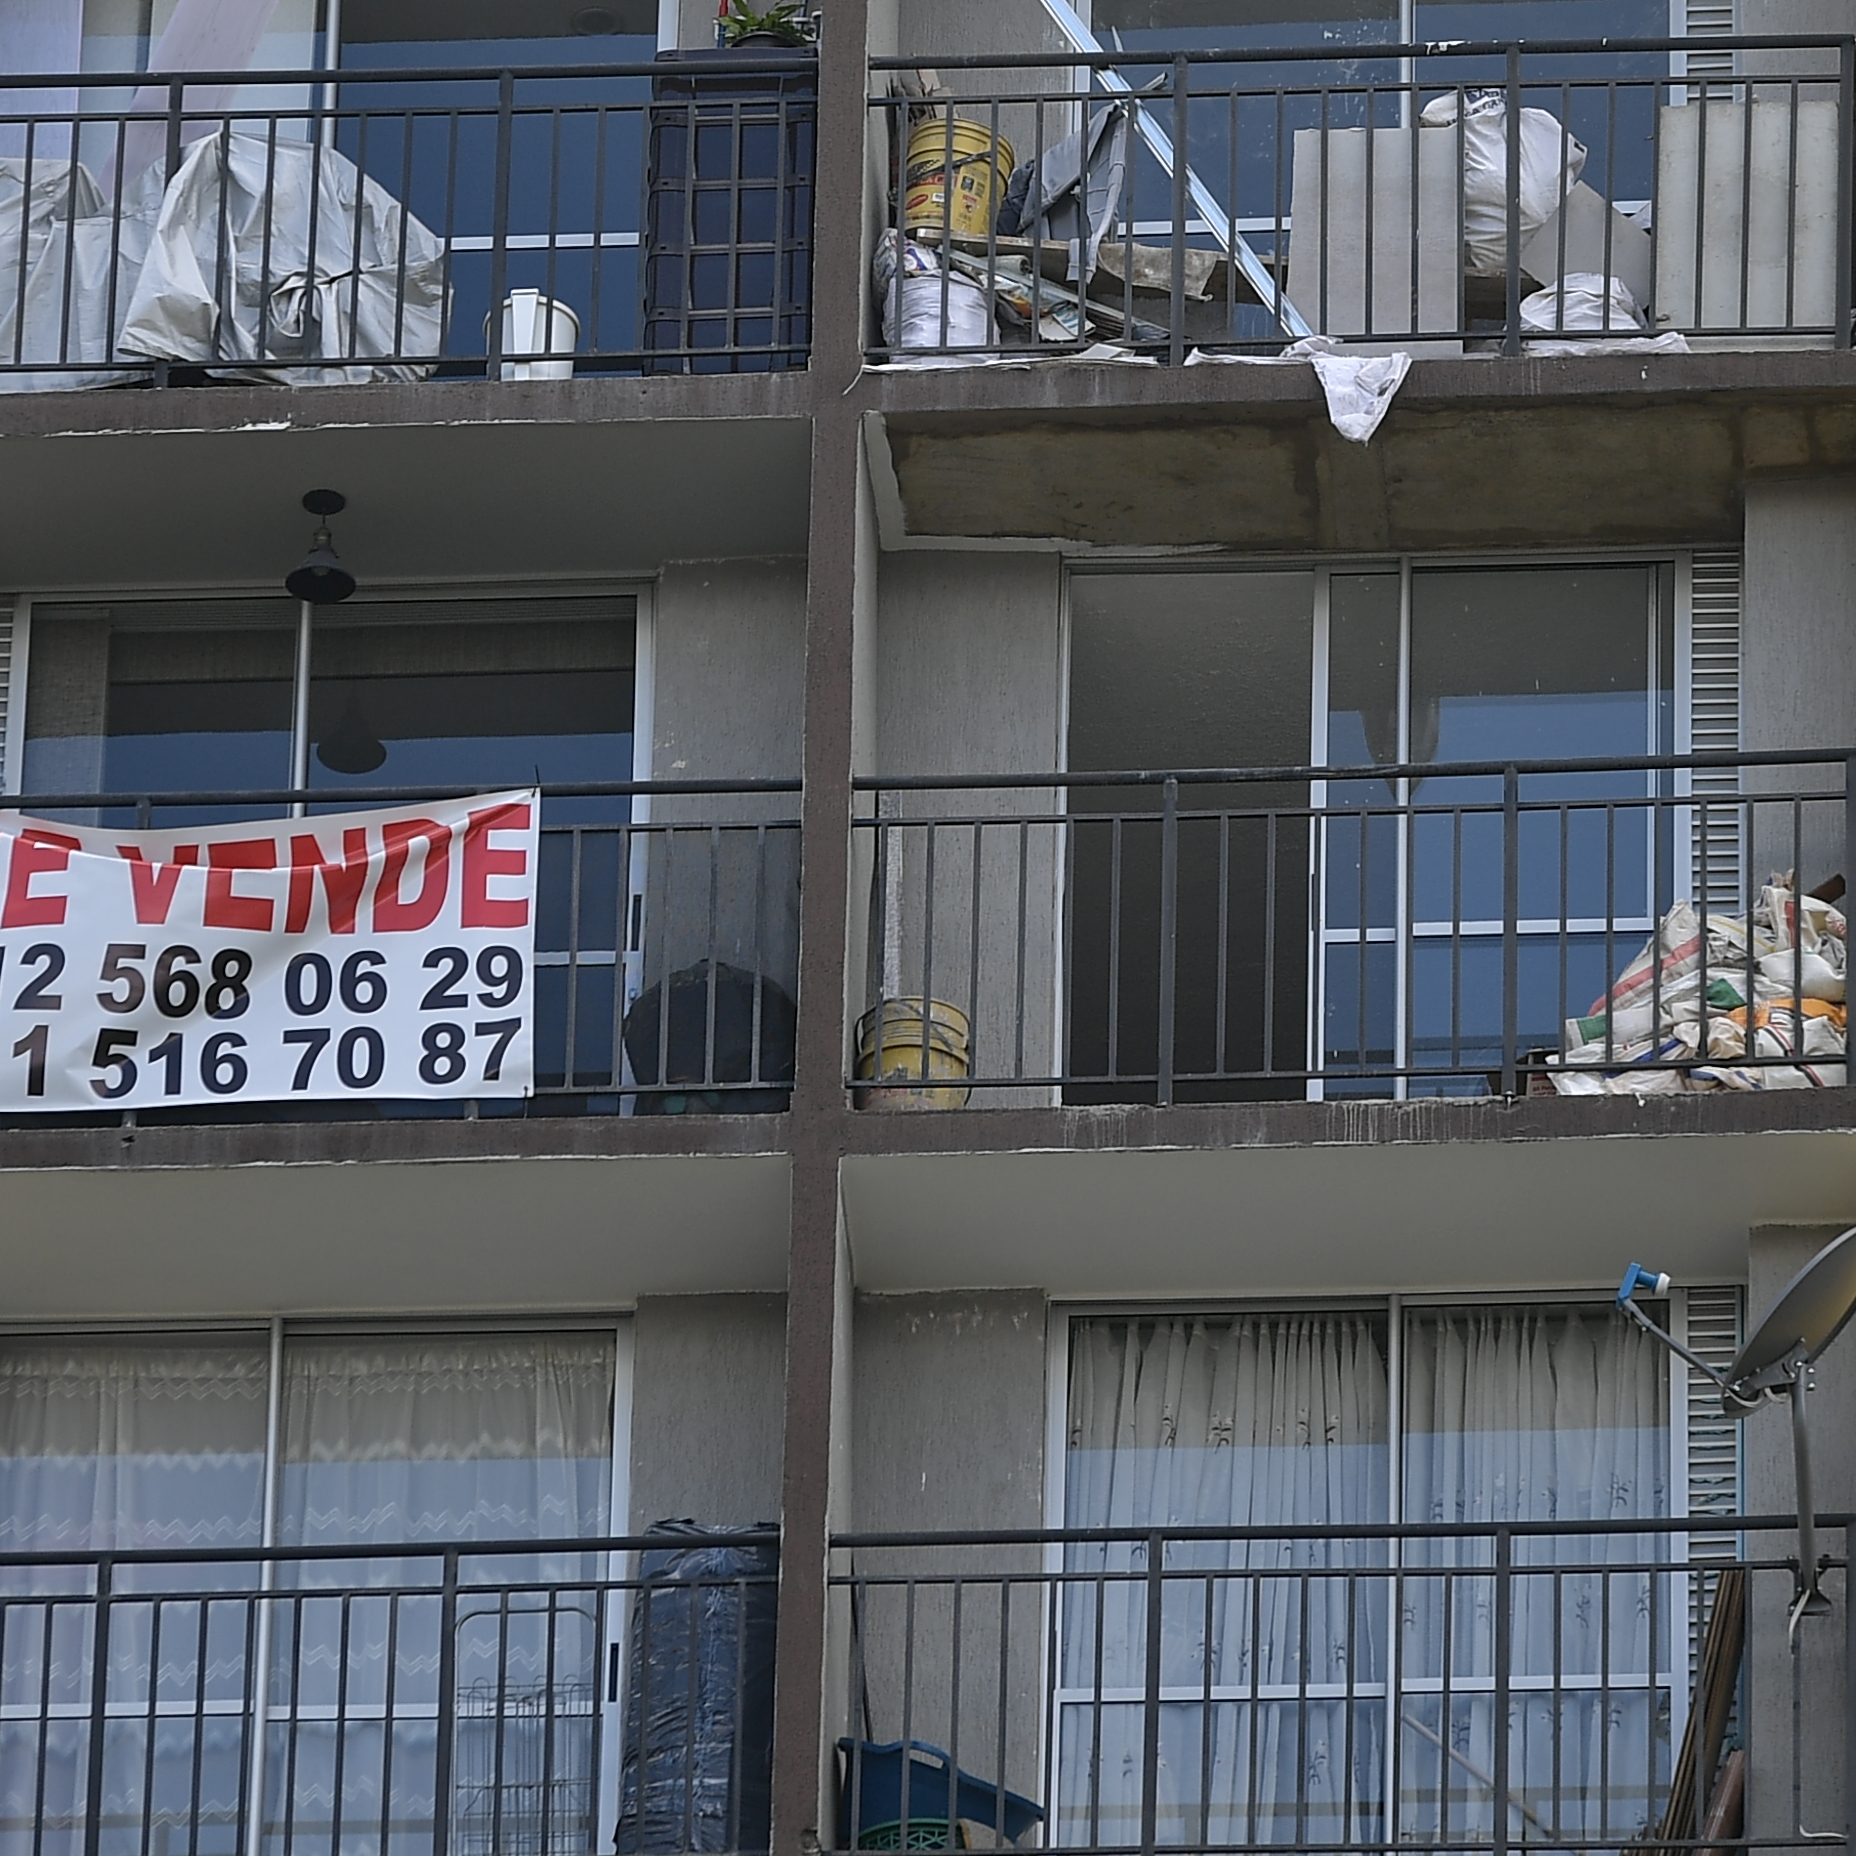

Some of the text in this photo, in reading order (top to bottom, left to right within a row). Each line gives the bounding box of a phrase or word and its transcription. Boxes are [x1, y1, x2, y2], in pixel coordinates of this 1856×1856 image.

[116, 802, 531, 935] VENDE
[96, 943, 253, 1020] 568
[284, 950, 388, 1017] 06
[419, 945, 524, 1011] 29
[89, 1027, 248, 1099] 516
[282, 1026, 385, 1091] 70
[418, 1016, 522, 1085] 87
